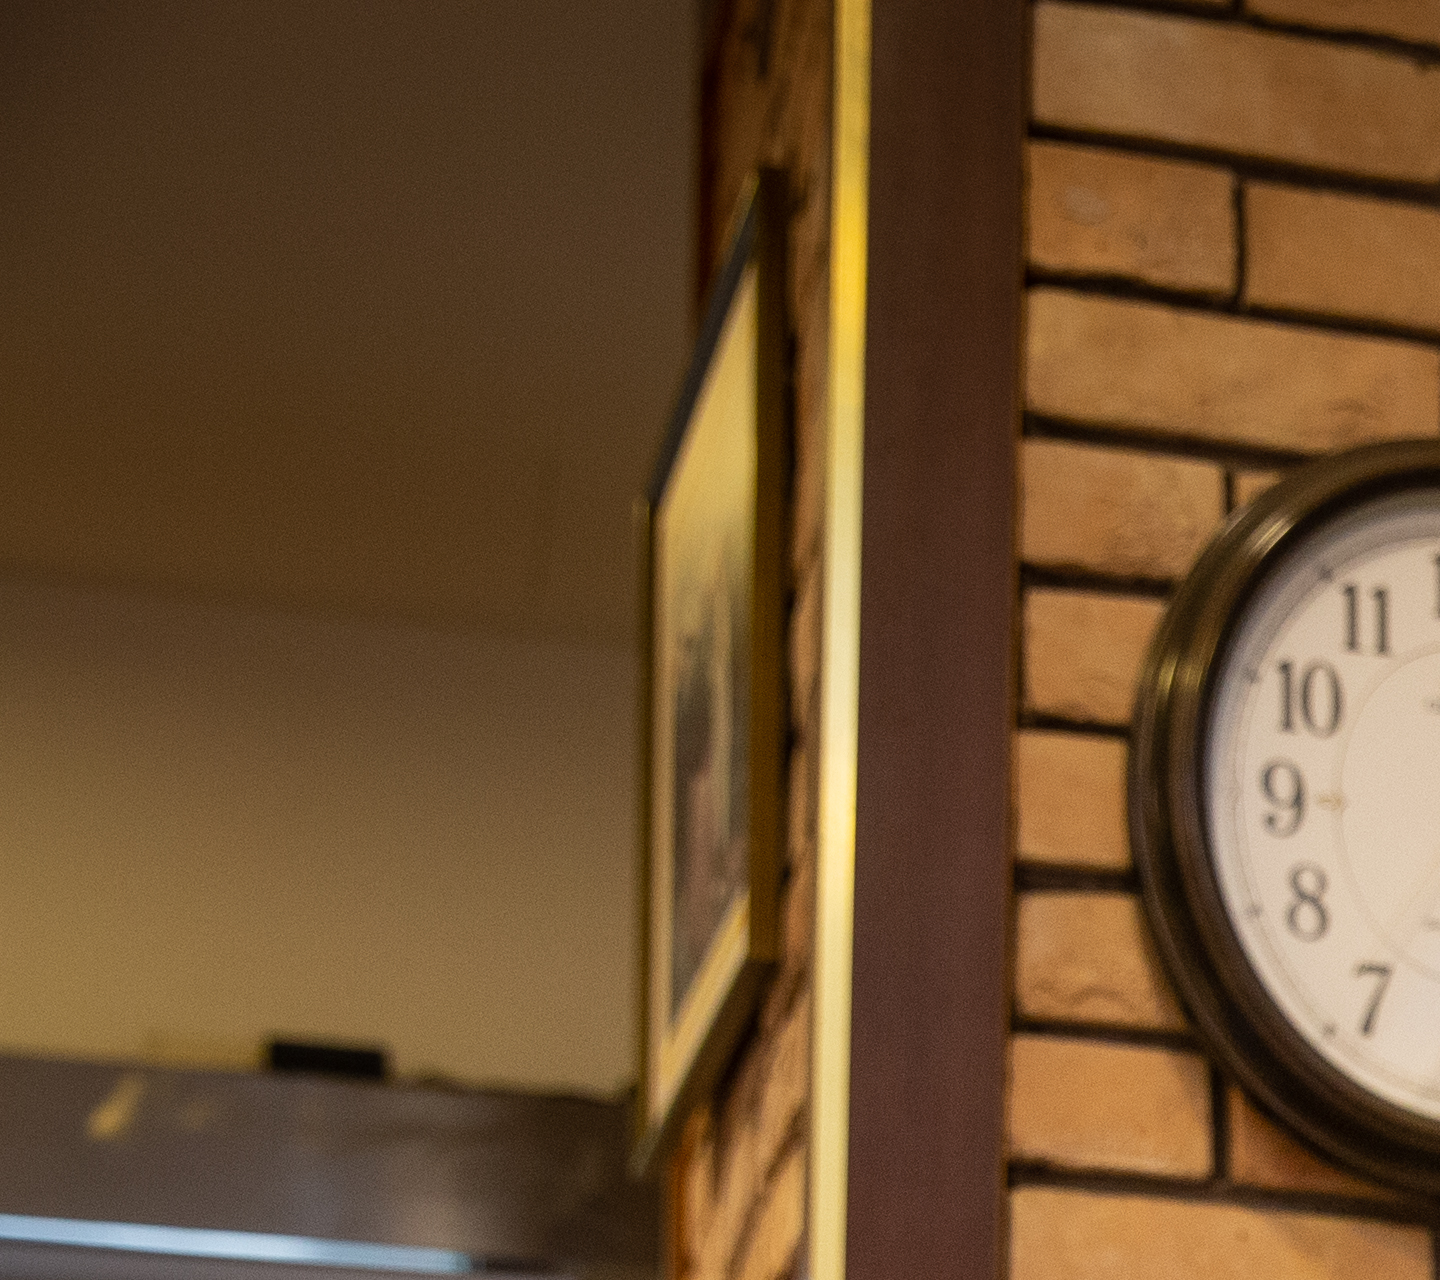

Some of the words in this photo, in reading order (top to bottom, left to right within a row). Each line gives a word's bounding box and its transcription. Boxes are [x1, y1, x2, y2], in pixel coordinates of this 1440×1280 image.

[1342, 584, 1392, 657] 11
[1277, 659, 1343, 738] 10
[1260, 759, 1304, 838] 9
[1286, 864, 1329, 942] 8
[1355, 964, 1393, 1037] 7
